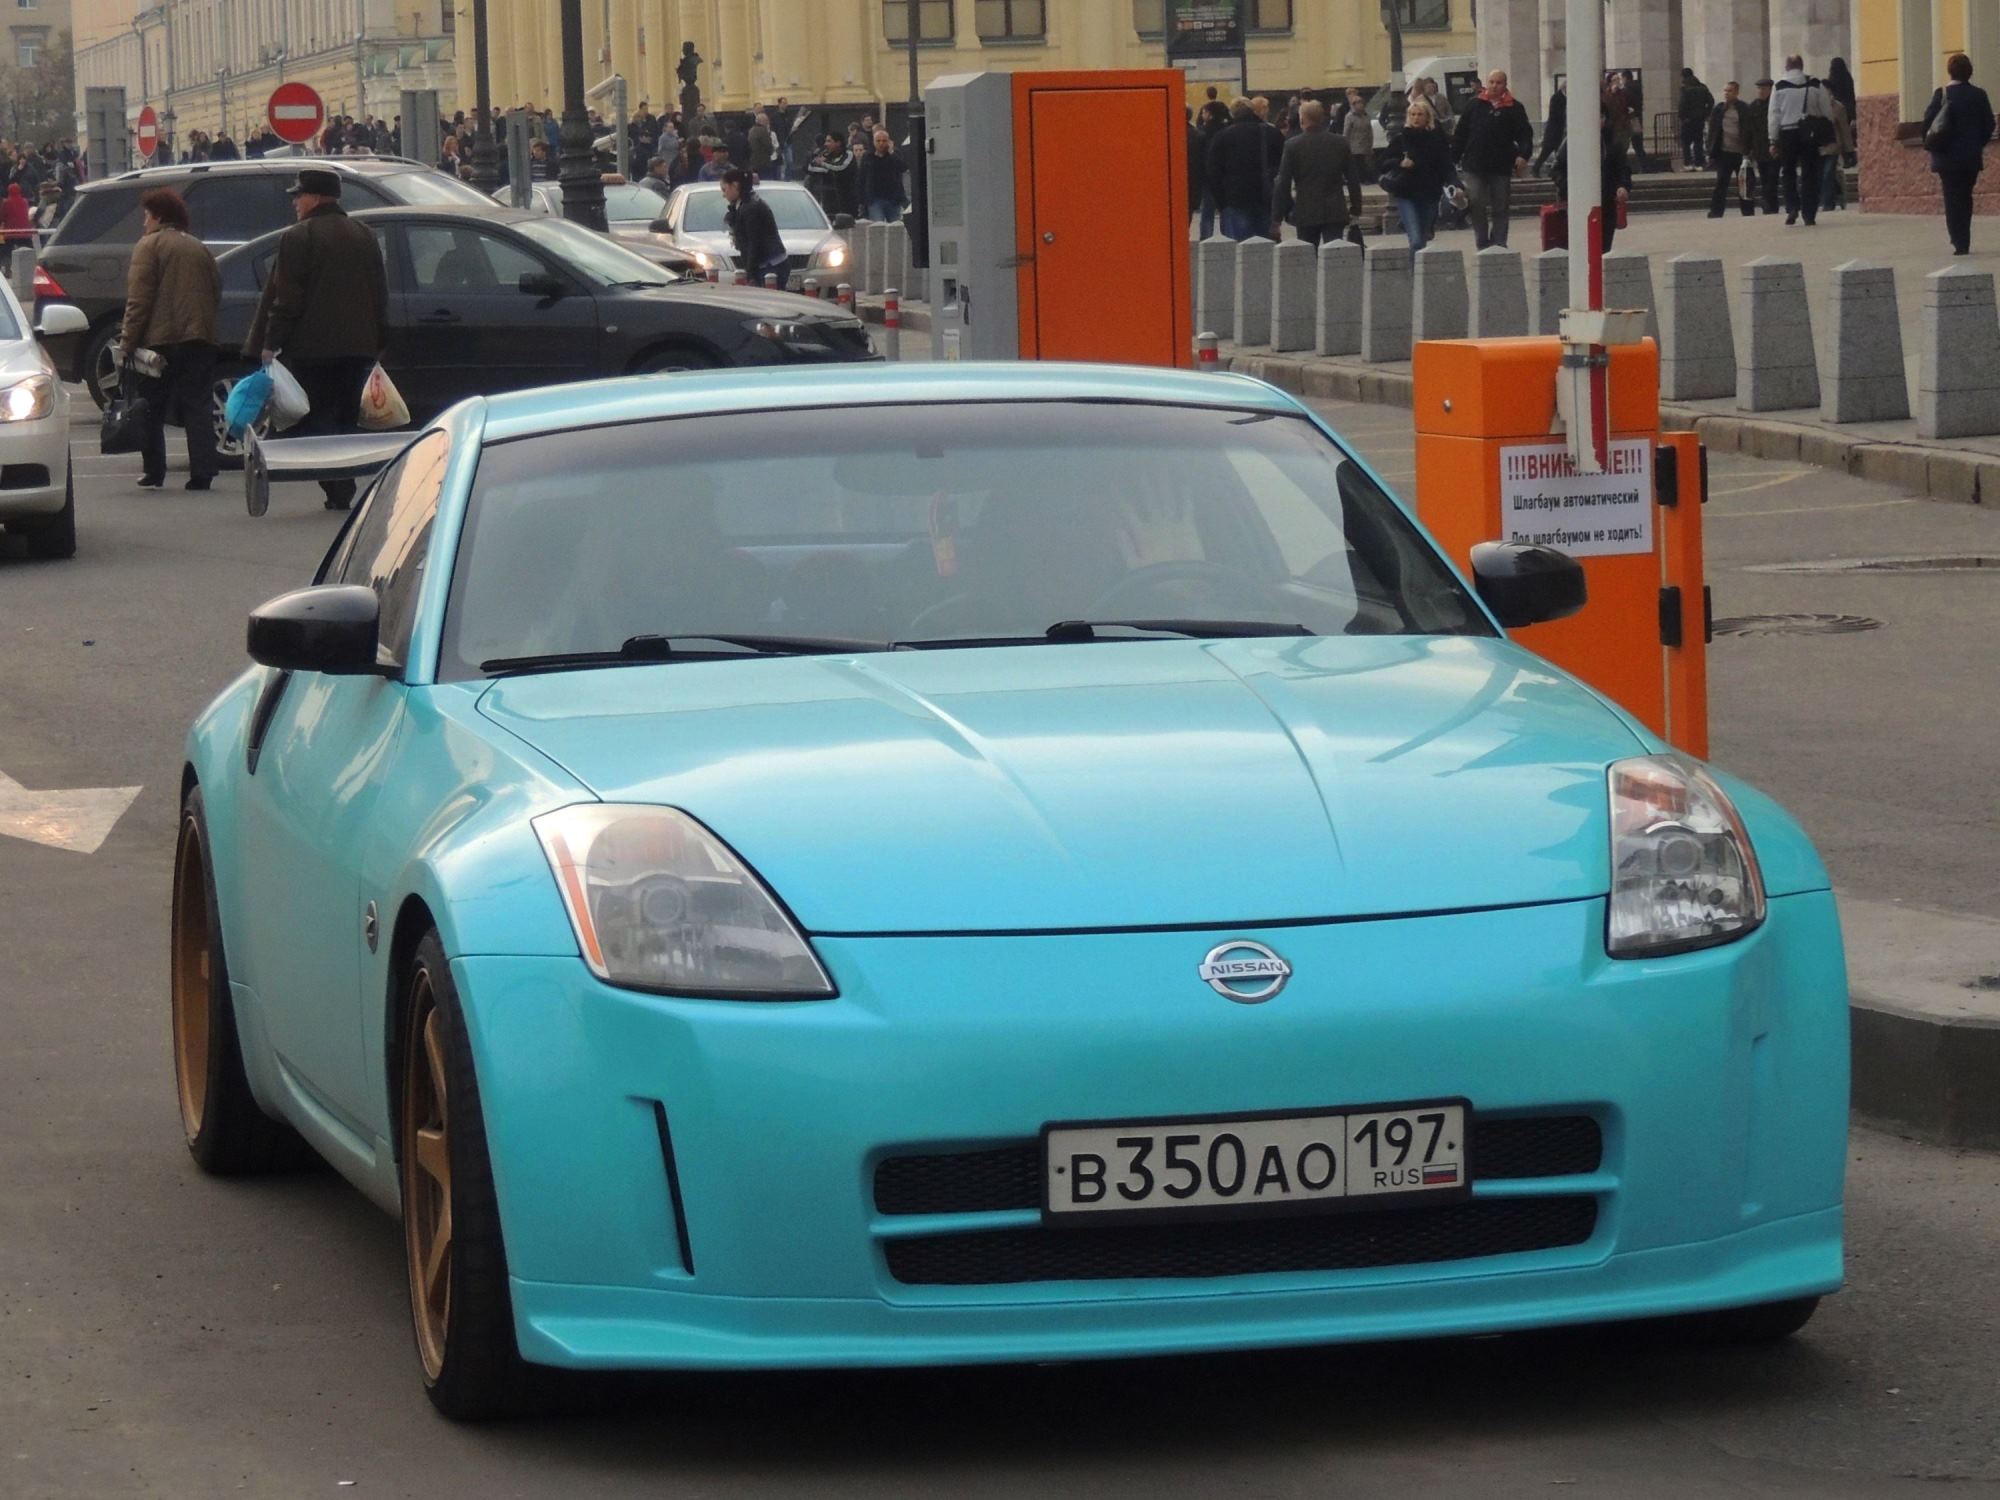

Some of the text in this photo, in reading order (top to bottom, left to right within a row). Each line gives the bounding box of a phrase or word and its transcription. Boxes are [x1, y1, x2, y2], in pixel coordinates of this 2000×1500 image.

[1508, 449, 1642, 481] !!!ВНИМЕ!!!
[1513, 489, 1639, 512] Шлагбаум автоматический
[1533, 528, 1590, 546] шлагбаумом
[1594, 531, 1605, 542] не
[1607, 524, 1642, 543] ходить!
[1211, 962, 1283, 975] NISSAN
[1071, 1113, 1446, 1203] В350АО 197
[1374, 1168, 1420, 1188] RUS
